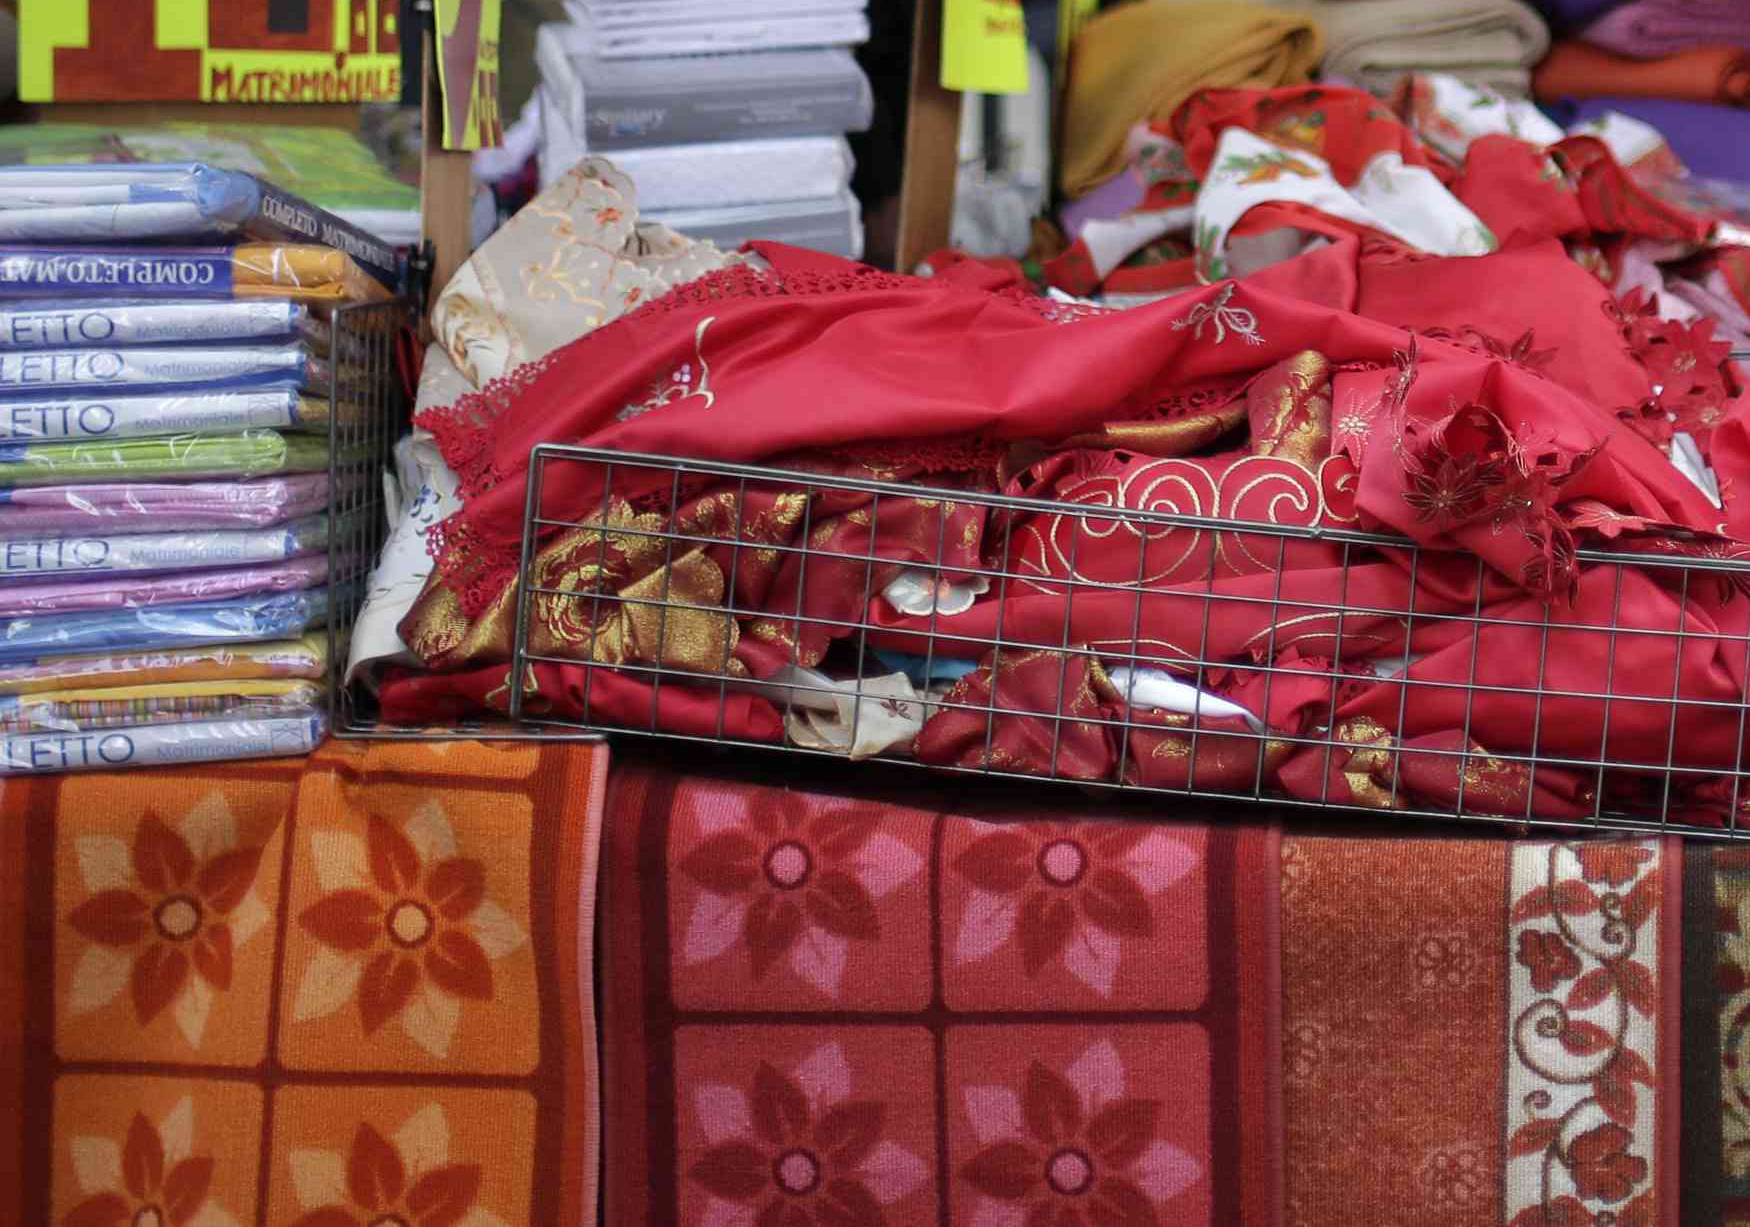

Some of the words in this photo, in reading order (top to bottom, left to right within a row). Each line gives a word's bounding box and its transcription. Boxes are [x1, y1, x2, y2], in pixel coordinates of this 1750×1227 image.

[262, 194, 318, 237] COMPLETO
[0, 312, 115, 345] ETTO
[0, 404, 115, 438] ETTO
